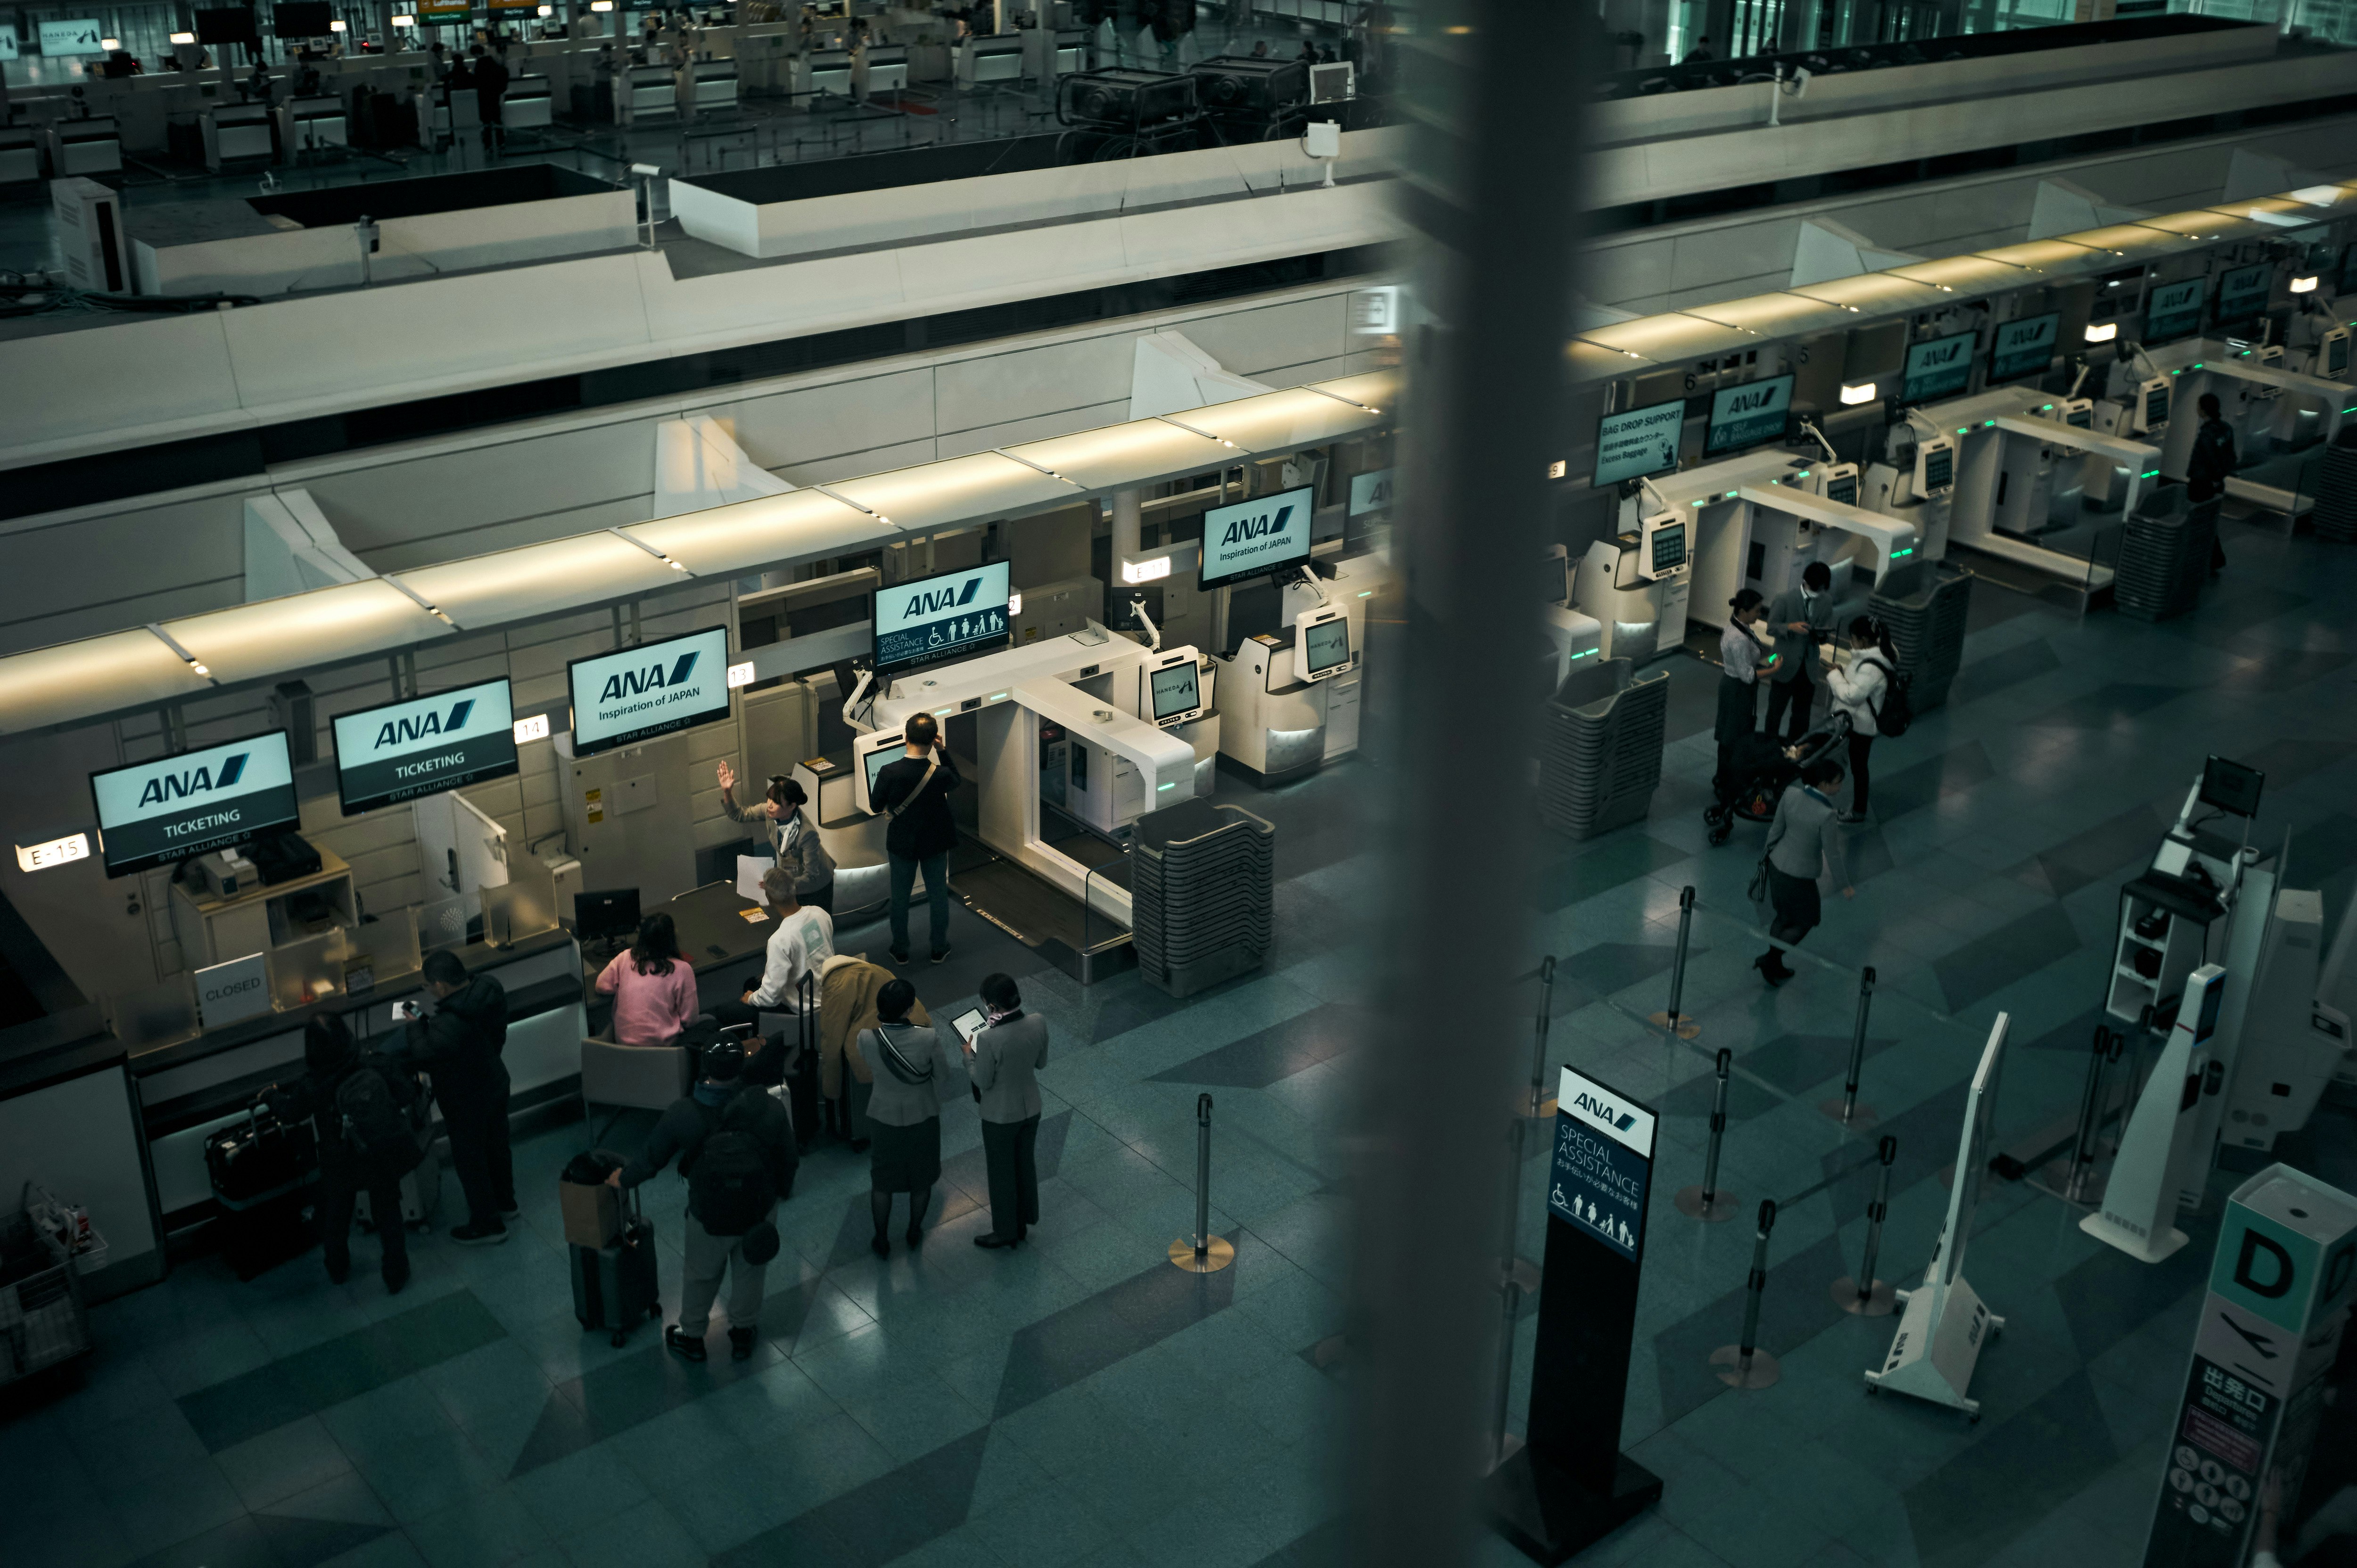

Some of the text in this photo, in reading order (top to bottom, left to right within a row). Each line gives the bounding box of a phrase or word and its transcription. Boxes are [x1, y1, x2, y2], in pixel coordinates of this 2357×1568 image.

[1799, 347, 1809, 363] 5
[1920, 347, 1947, 368] ANA
[1685, 374, 1696, 390] 6
[1727, 392, 1760, 415] ANA
[1602, 410, 1681, 436] BAG DROP SUPPORT
[1221, 514, 1268, 546] ANA
[1220, 536, 1292, 561] Inspiration of JAPAN
[1229, 564, 1276, 581] STAR ALLIANCE
[903, 587, 955, 619] ANA
[881, 632, 909, 646] SPECIAL
[881, 637, 924, 655] ASSISTANCE
[910, 645, 967, 665] STAR ALLIANCE
[599, 663, 666, 704] ANA
[730, 668, 747, 683] 13
[1156, 684, 1180, 695] HANEDA
[599, 686, 701, 721] Inspiration of JAPAN
[374, 711, 441, 750] ANA
[522, 722, 541, 737] 14
[616, 720, 682, 743] STAR ALLIANCE
[395, 752, 465, 780] TICKETING
[138, 766, 213, 808] ANA
[389, 777, 463, 802] STAR ALLIANCE
[163, 809, 241, 838] TICKETING
[31, 840, 78, 866] E-15
[158, 834, 240, 862] STAR ALLIANCE
[206, 977, 260, 1002] CLOSED
[1574, 1092, 1613, 1125] ANA
[1560, 1124, 1613, 1166] SPECIAL
[1558, 1141, 1640, 1198] ASSISTANCE
[1557, 1158, 1639, 1211] お手伝いが必要なお客様
[2233, 1226, 2295, 1299] D
[2202, 1365, 2267, 1413] 出発口
[2204, 1384, 2258, 1421] Departures
